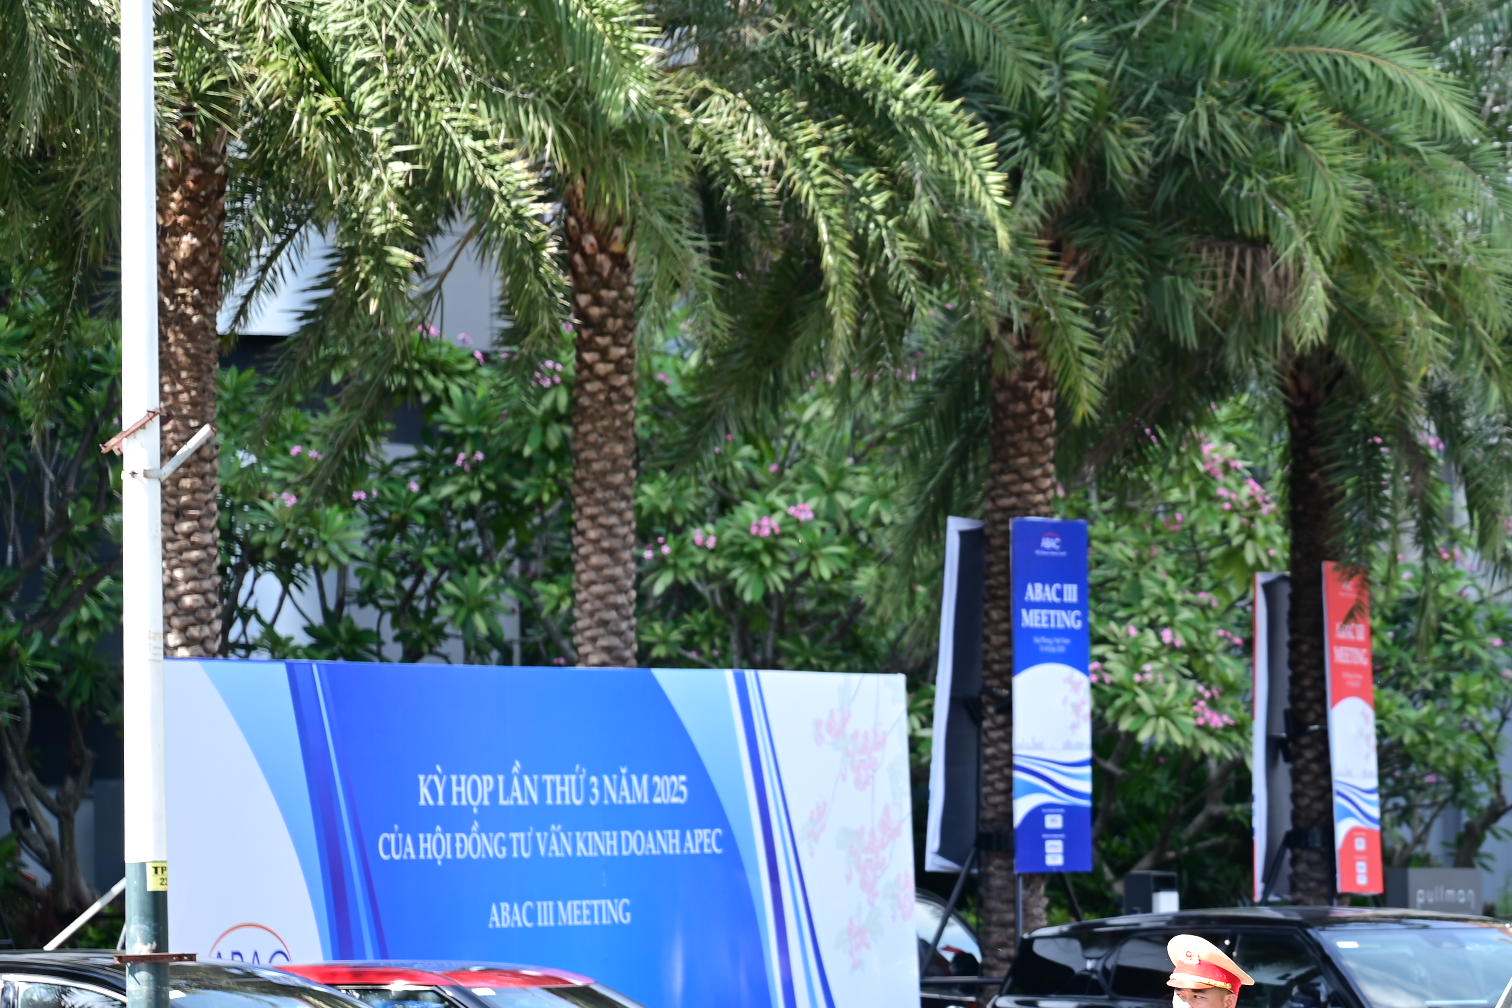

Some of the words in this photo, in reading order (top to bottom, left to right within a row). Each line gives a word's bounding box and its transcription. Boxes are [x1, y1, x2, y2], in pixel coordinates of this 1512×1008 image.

[1024, 582, 1061, 603] ABAC
[1063, 583, 1079, 603] III
[1020, 608, 1083, 630] MEETING
[418, 764, 446, 806] KỲ
[450, 774, 494, 814] HỌP
[498, 760, 539, 806] LẦN
[542, 764, 587, 805] THỨ
[589, 775, 599, 805] 3
[603, 767, 650, 804] NĂM
[652, 774, 688, 803] 2025
[378, 824, 416, 860] CỦA
[419, 825, 452, 866] HỘI
[454, 820, 507, 859] ĐỒNG
[509, 826, 534, 858] TƯ
[576, 831, 618, 857] KINH
[621, 829, 682, 855] DOANH
[684, 828, 723, 854] APEC
[1416, 886, 1475, 909] pullman
[488, 901, 533, 929] ABAC
[537, 901, 555, 927] III
[557, 898, 632, 926] MEETING
